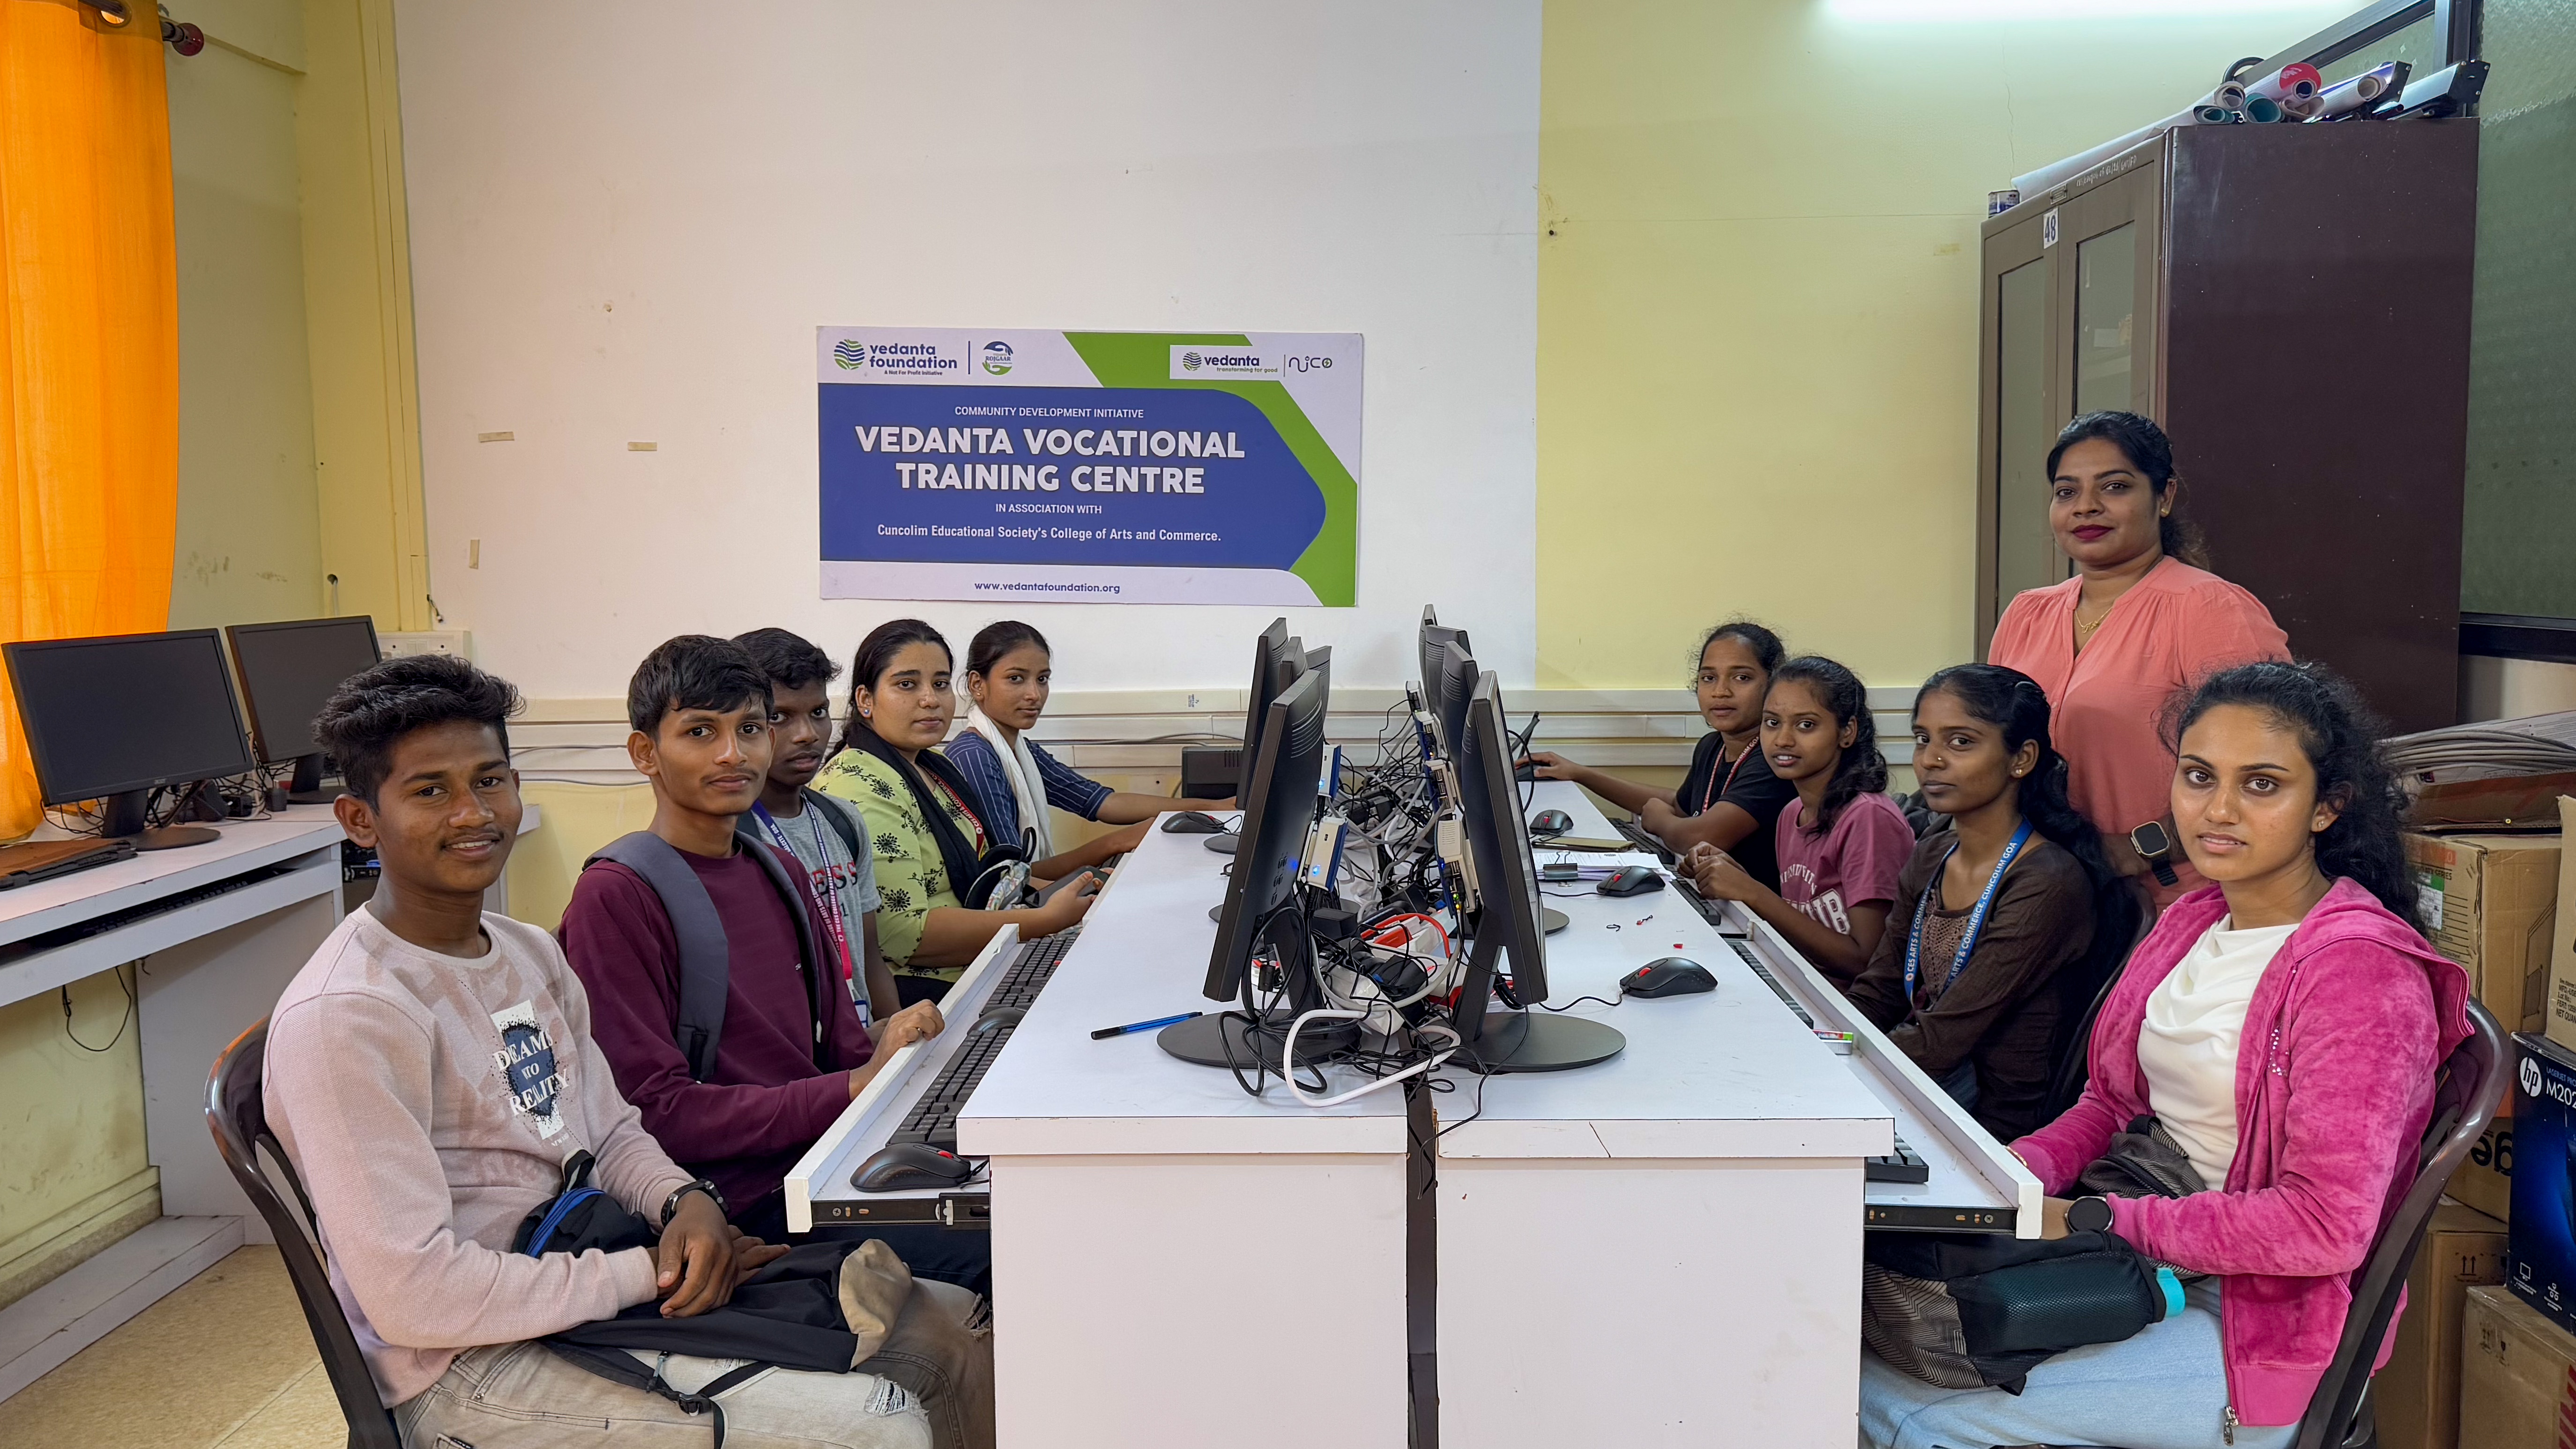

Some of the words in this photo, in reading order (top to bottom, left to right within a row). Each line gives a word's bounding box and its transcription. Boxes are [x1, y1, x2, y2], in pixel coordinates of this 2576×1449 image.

[2045, 215, 2056, 242] 48
[870, 343, 935, 355] vedanta
[870, 356, 957, 369] foundation
[1204, 355, 1259, 366] vedanta
[955, 406, 1017, 416] COMMUNITY
[1019, 407, 1092, 417] DEVELOPMENT
[1094, 409, 1144, 418] INITIATIVE
[855, 426, 1014, 454] VEDANTA
[1023, 429, 1245, 458] VOCATIONAL
[895, 462, 1059, 491] TRAINING
[1071, 466, 1204, 493] CENTRE
[996, 504, 1006, 512] IN
[1009, 504, 1074, 513] ASSOCIATION
[1077, 505, 1102, 514] WITH
[878, 524, 928, 536] Cuncolim
[931, 525, 994, 537] Educational
[998, 526, 1047, 541] Society's
[1050, 527, 1092, 541] College
[1095, 528, 1107, 539] of
[1109, 528, 1132, 540] Arts
[1136, 529, 1155, 540] and
[1159, 529, 1221, 541] Commerce.
[974, 580, 1120, 594] www.vedantafoundation.org
[1951, 958, 1963, 978] ARTS
[1961, 900, 1986, 950] COMMERCE,
[1981, 860, 2008, 900] CUNCOLIM
[2003, 842, 2017, 859] GOA
[1909, 938, 1918, 958] ARTS
[2556, 1007, 2564, 1018] NET
[2522, 1057, 2539, 1097] hp
